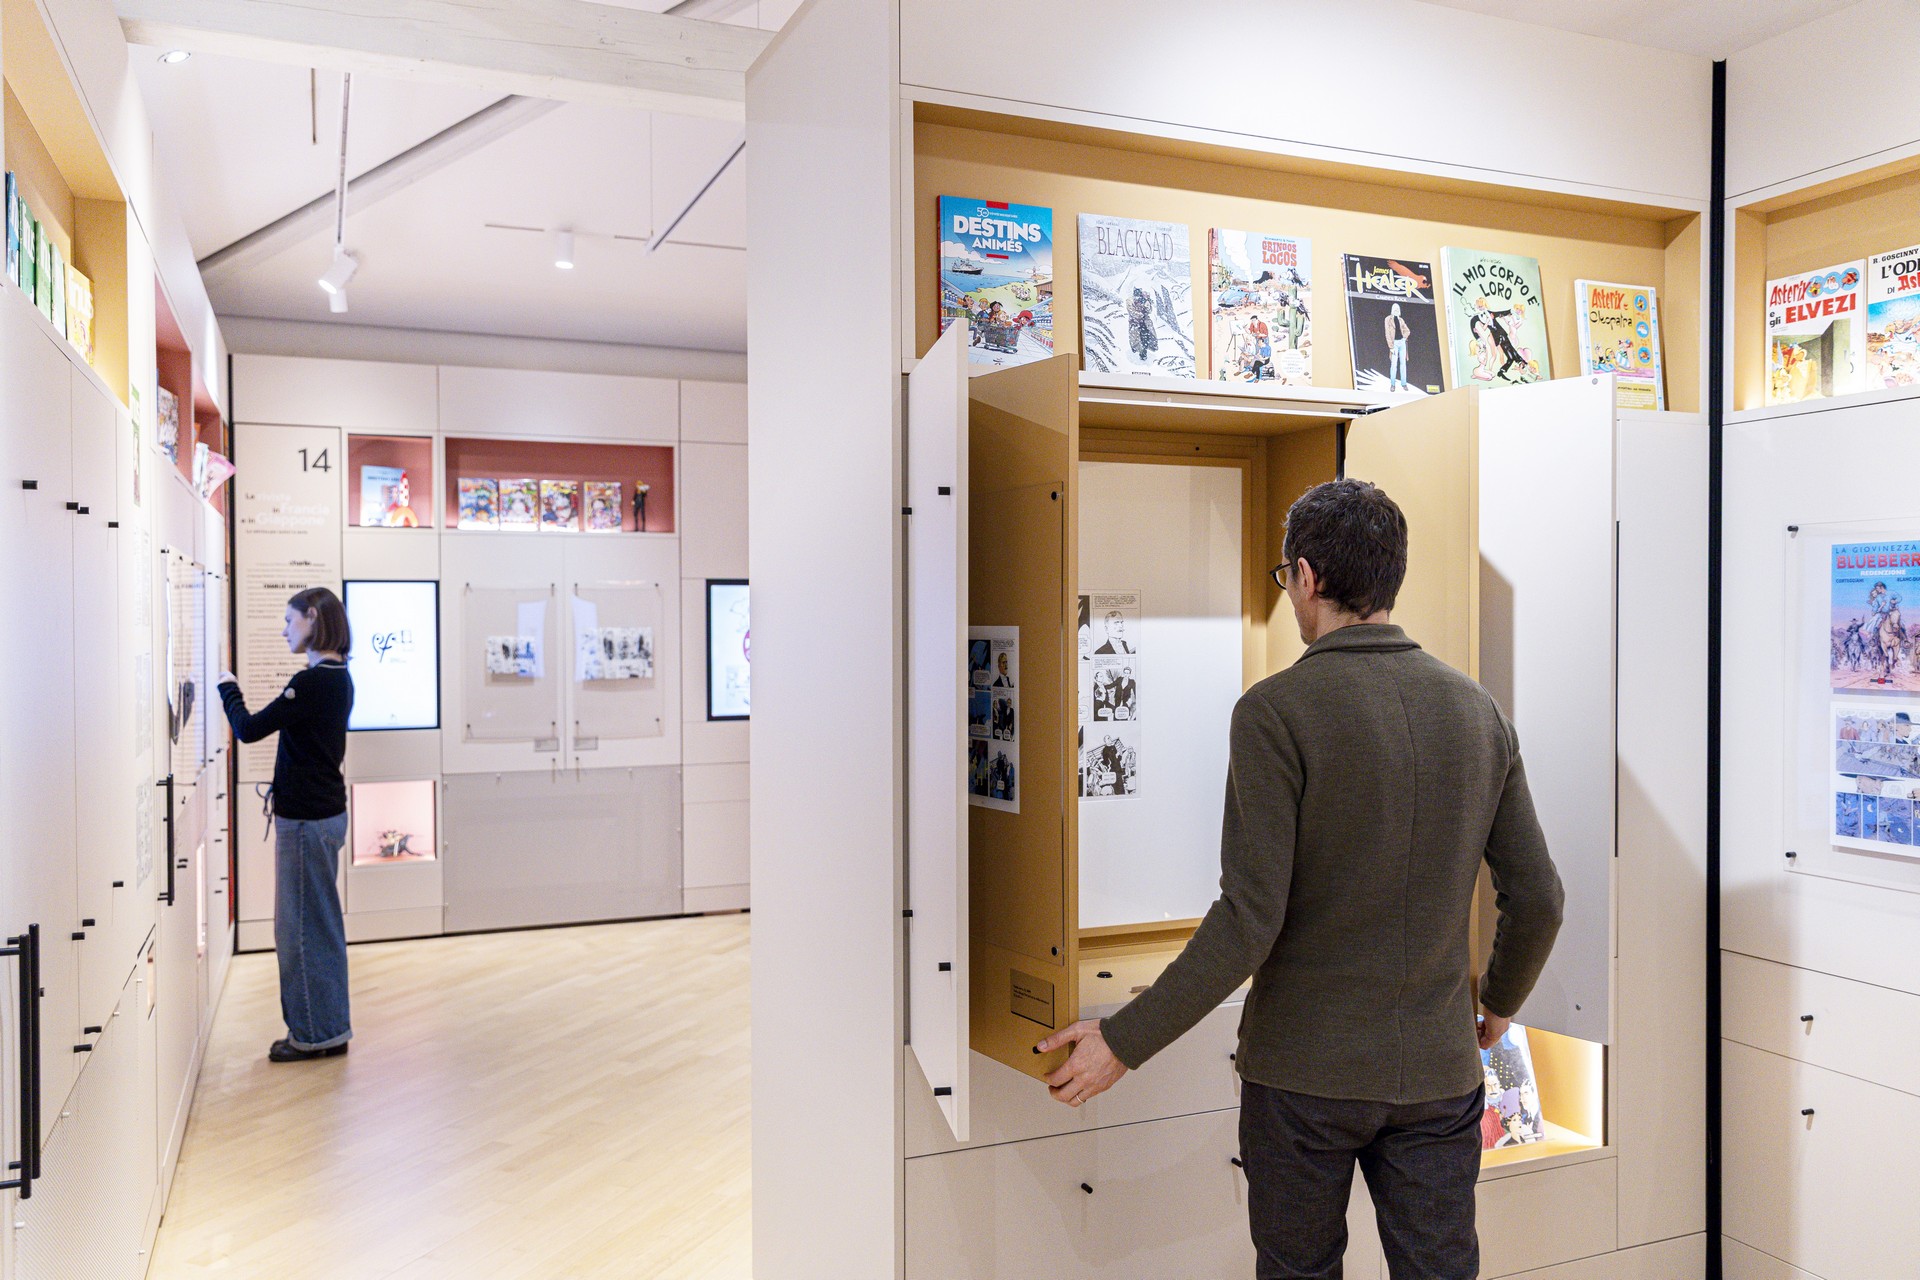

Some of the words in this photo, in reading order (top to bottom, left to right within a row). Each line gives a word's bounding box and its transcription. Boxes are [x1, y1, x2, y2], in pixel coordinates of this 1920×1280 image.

[953, 214, 1042, 243] DESTINS
[972, 236, 1023, 253] ANIMÉS
[1096, 226, 1174, 262] BLACKSAD
[1262, 240, 1297, 254] GRINGOS
[1262, 250, 1298, 268] LOCOS
[1881, 248, 1919, 262] GOSCINNY
[1453, 282, 1467, 296] IL
[1463, 264, 1486, 284] MIO
[1489, 264, 1530, 296] CORPO
[1479, 281, 1512, 300] LORO
[1592, 288, 1625, 310] Asterix
[1769, 280, 1811, 307] Asterix
[1769, 310, 1775, 318] e
[1785, 293, 1857, 324] ELVEZI
[1590, 310, 1632, 331] Cleopatra
[1769, 316, 1781, 328] gli
[298, 448, 332, 472] 14
[1852, 544, 1917, 553] GIOVINEZZA
